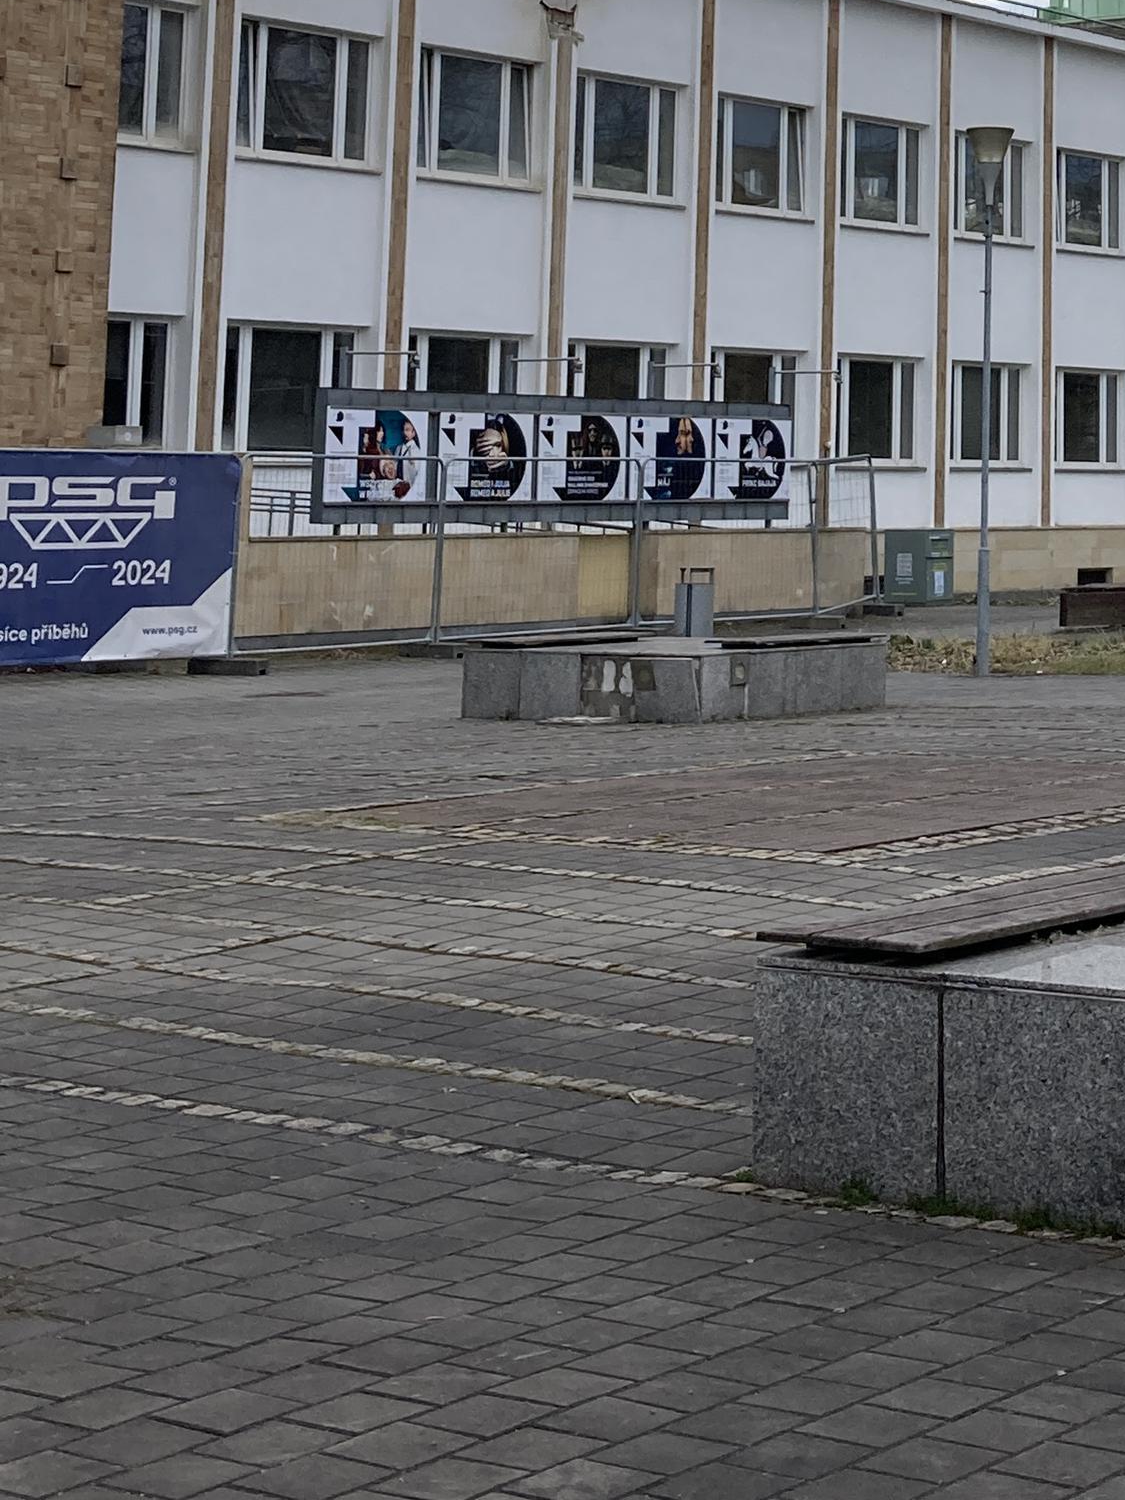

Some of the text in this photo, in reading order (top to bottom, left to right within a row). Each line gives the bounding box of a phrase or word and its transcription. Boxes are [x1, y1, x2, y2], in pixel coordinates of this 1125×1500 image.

[112, 559, 171, 586] 2024
[31, 622, 89, 645] příběhů
[142, 625, 198, 637] www.psg.cz
